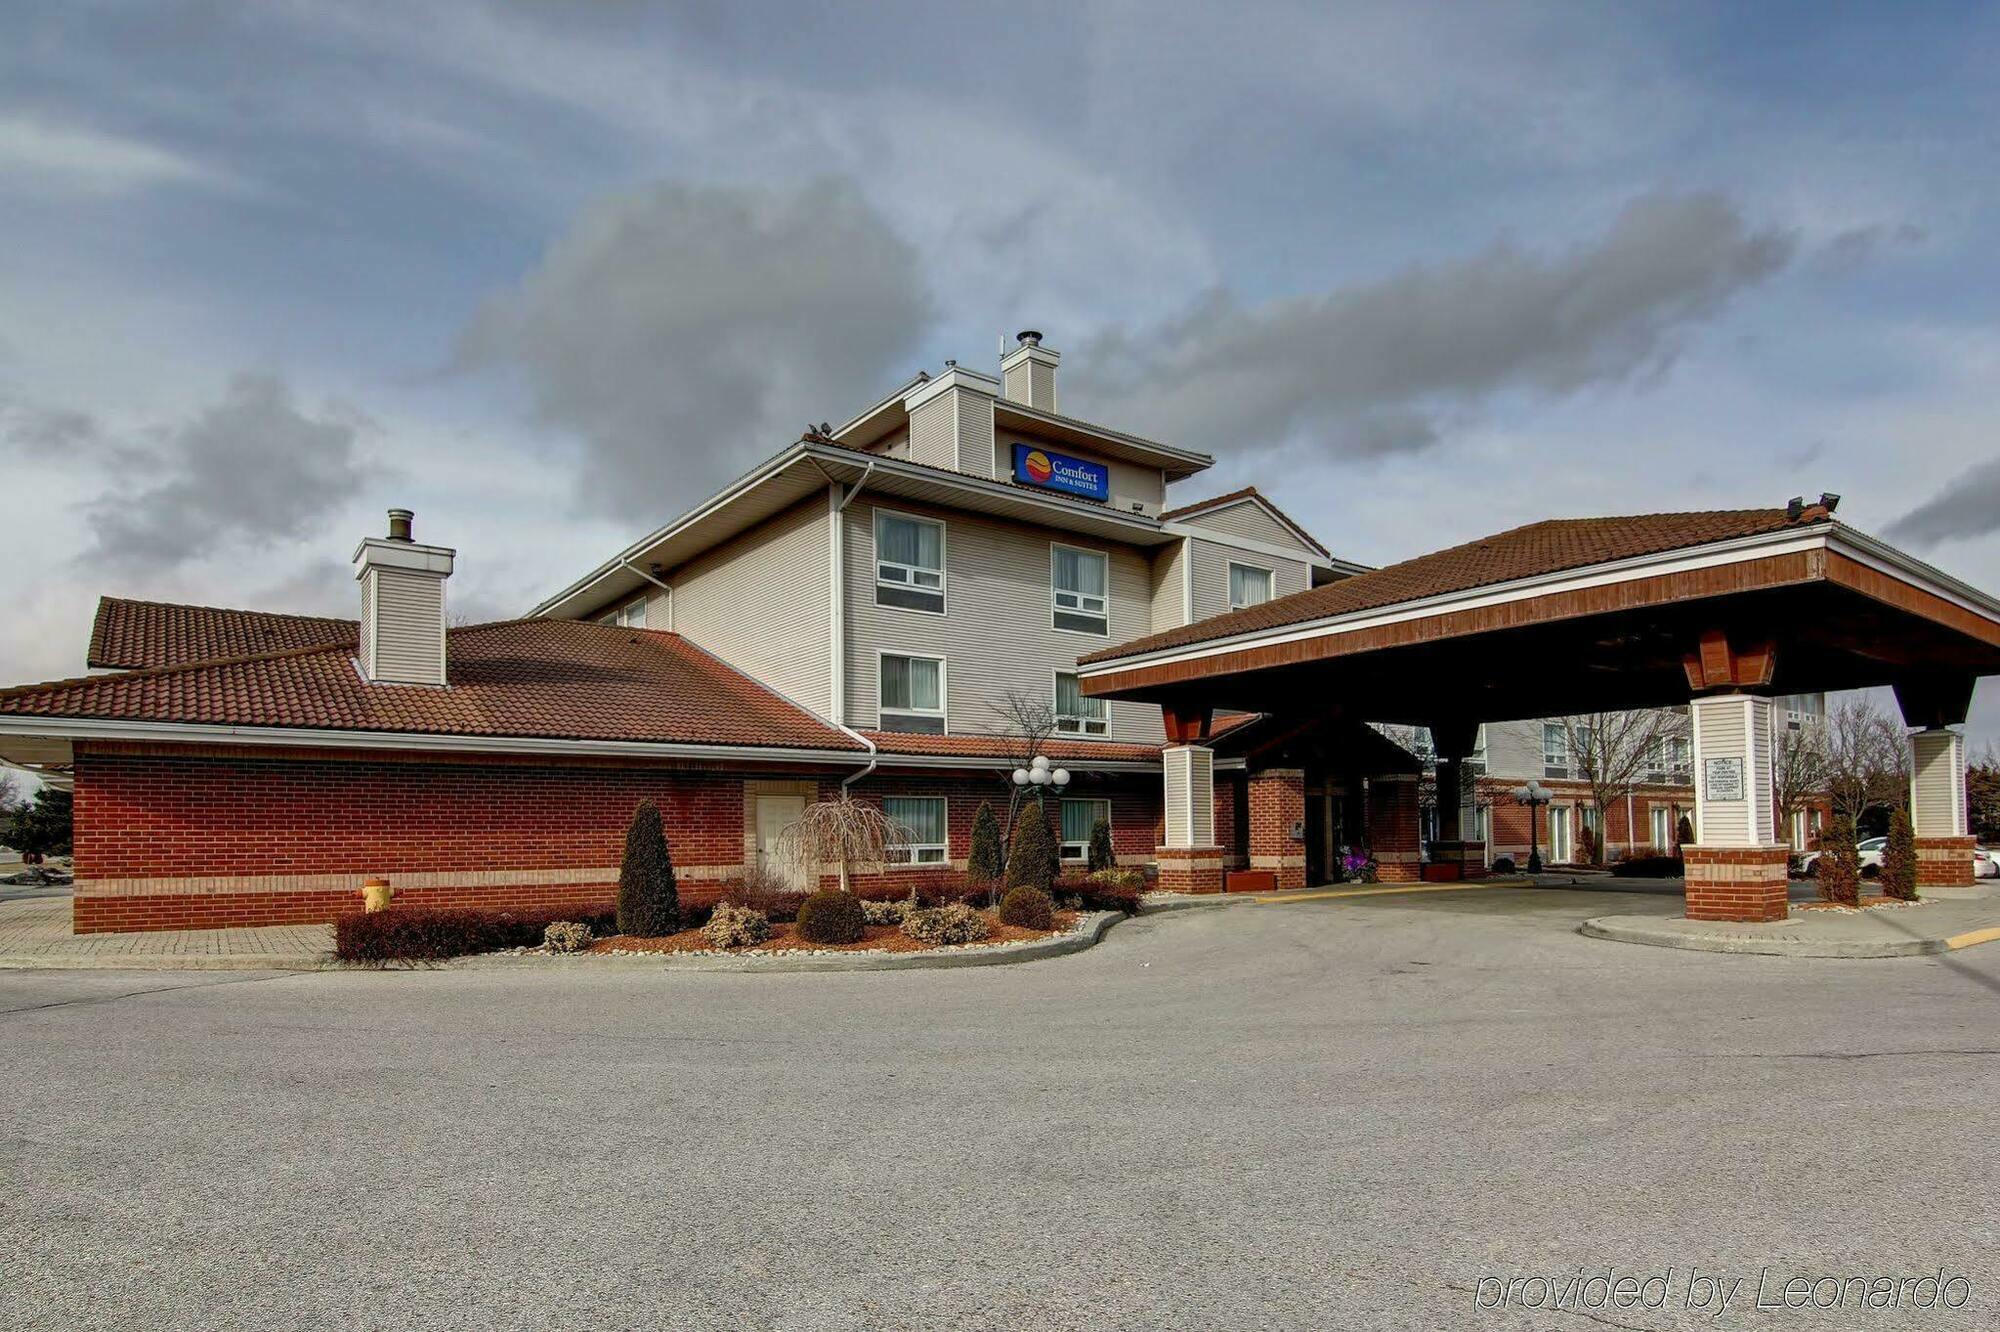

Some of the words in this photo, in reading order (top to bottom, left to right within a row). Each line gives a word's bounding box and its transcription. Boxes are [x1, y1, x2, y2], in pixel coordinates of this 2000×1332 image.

[1052, 461, 1098, 483] Comfort
[1055, 475, 1069, 484] INN
[1074, 480, 1098, 491] SUITES
